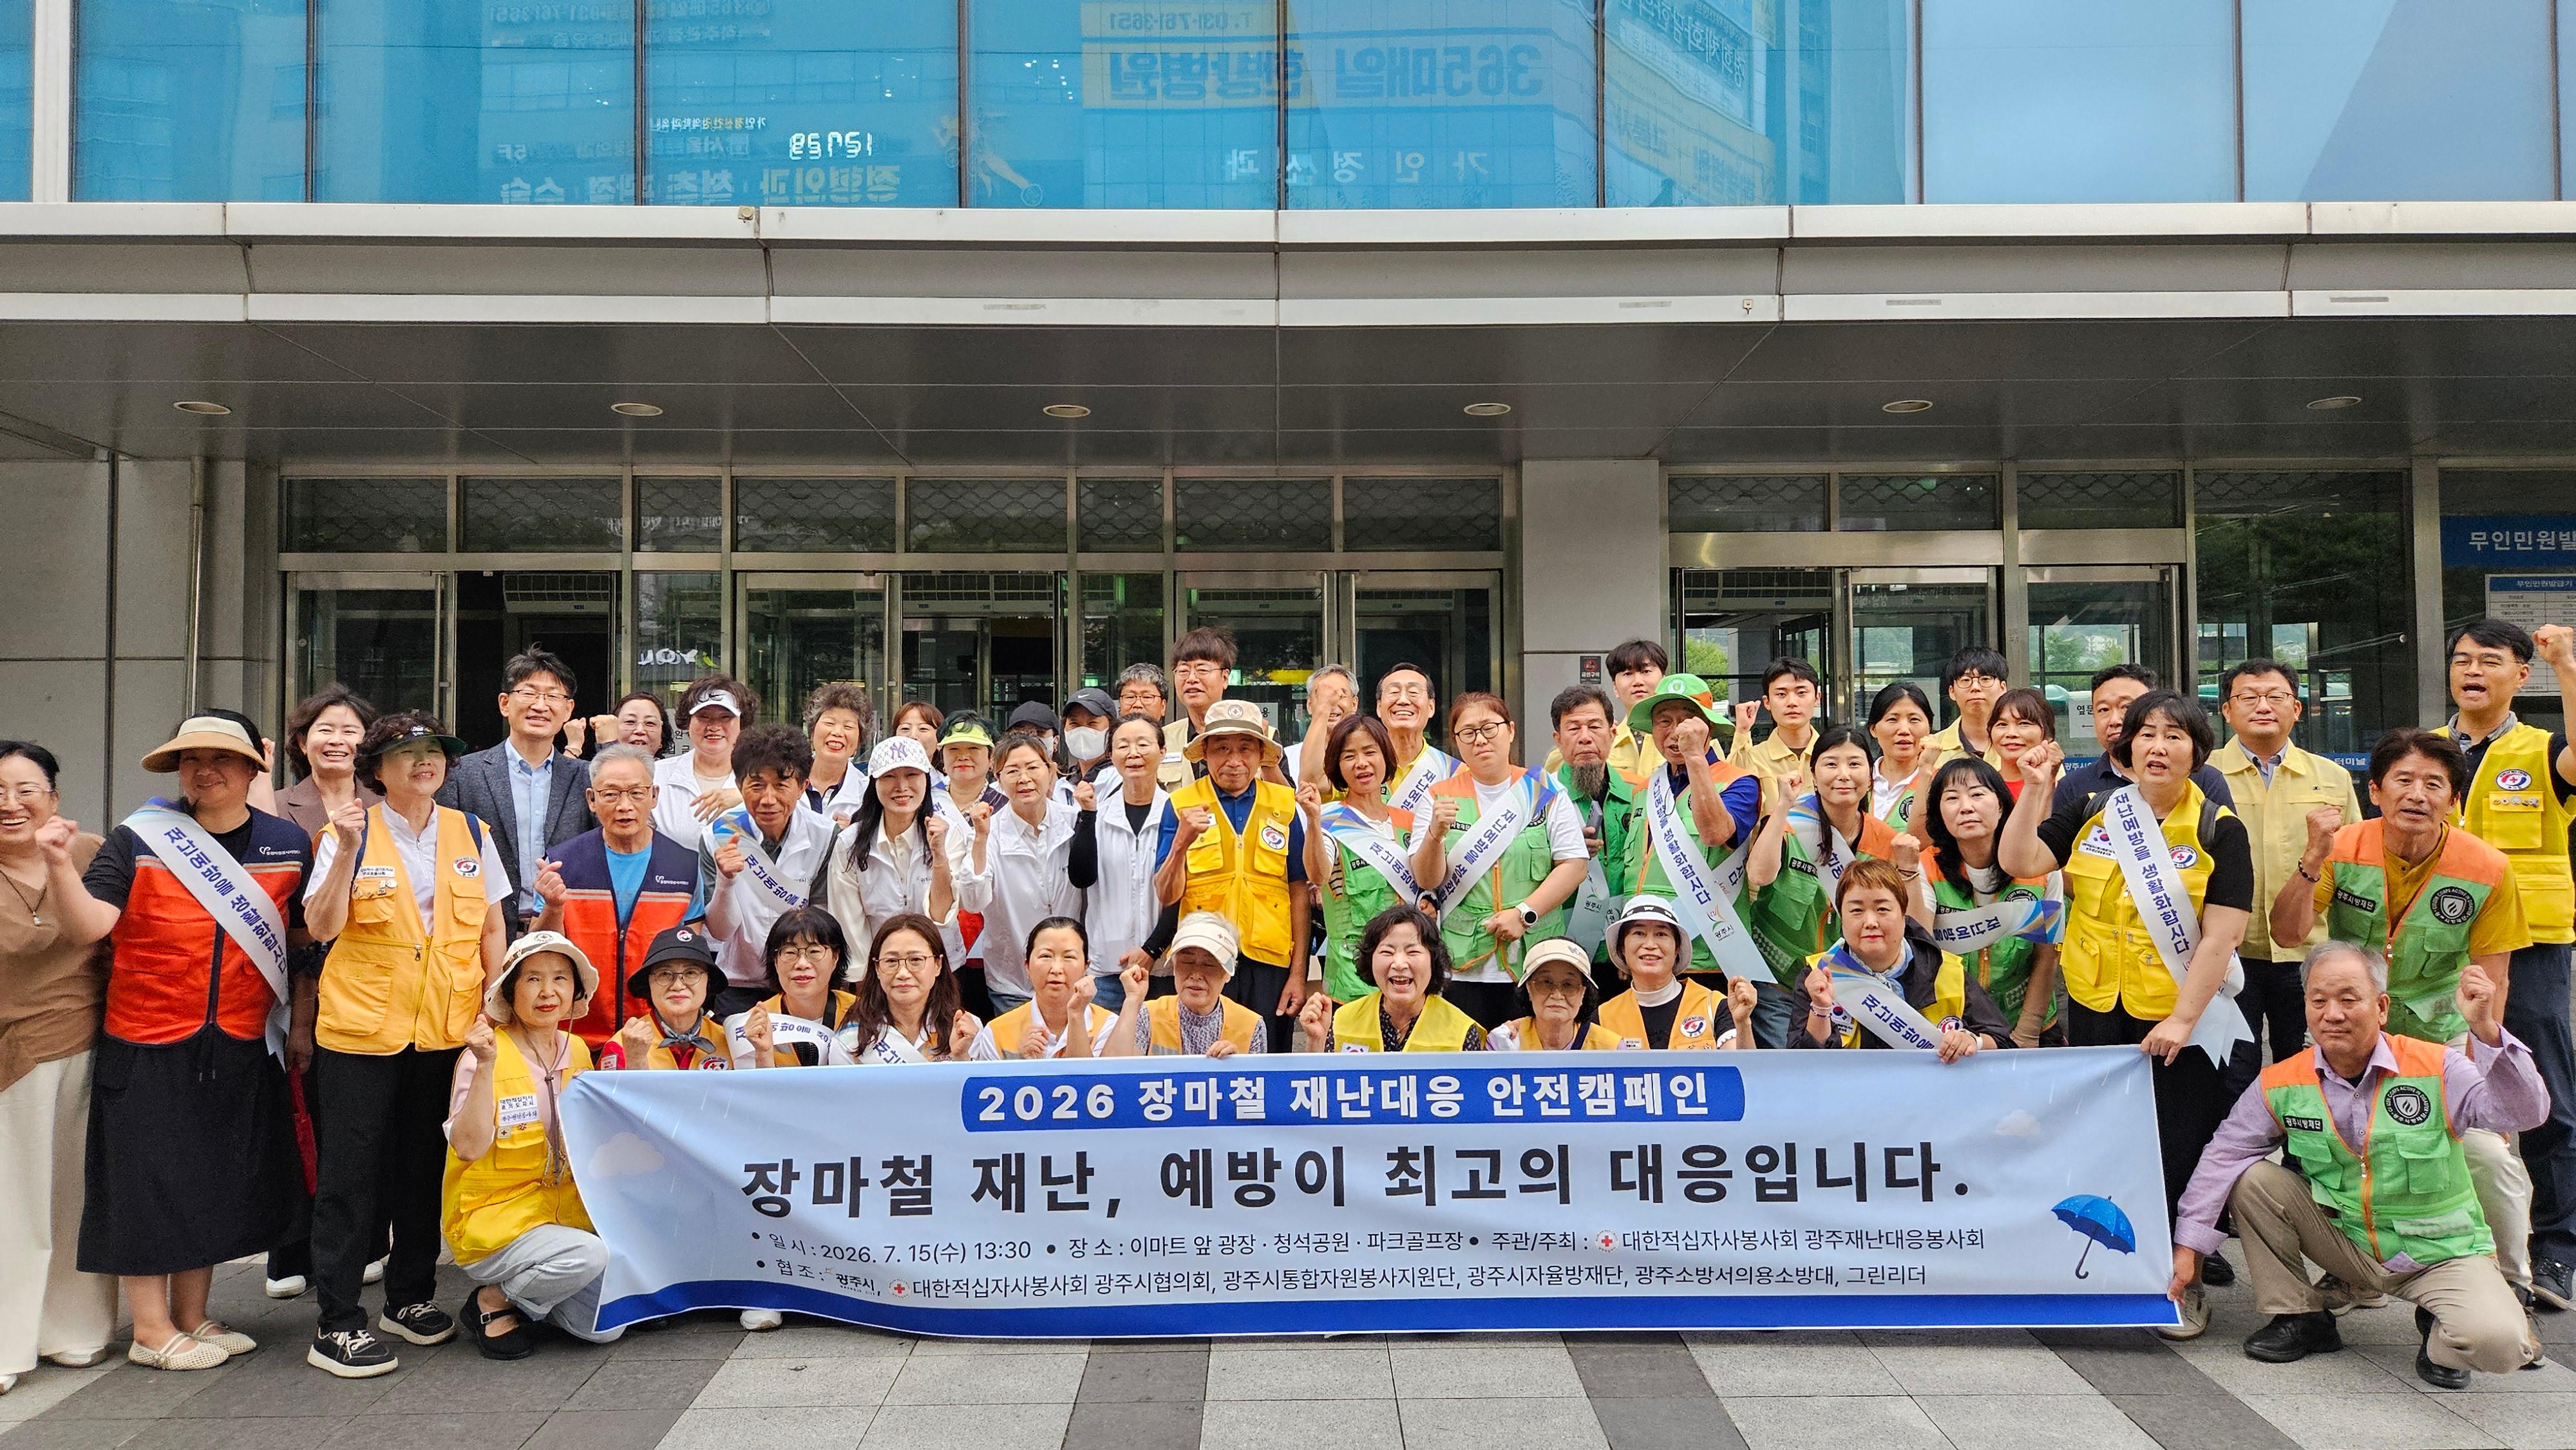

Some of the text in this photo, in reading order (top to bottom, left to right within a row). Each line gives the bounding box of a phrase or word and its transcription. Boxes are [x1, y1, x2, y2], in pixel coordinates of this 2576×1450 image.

[164, 826, 236, 897] 재난예방을
[1464, 809, 1517, 865] 재난예방을
[744, 853, 799, 905] 재난예방을
[2114, 793, 2152, 861] 재난예방을
[2141, 863, 2190, 954] 생활화합시다
[2336, 890, 2374, 910] 광주시방재단
[1715, 925, 1734, 939] 광주시
[978, 1071, 1710, 1123] 2026 장마철 재난대응 안전캠페인
[2285, 1117, 2321, 1129] 광주시방재단
[741, 1142, 1967, 1218] 장마철 재난, 예방이 최고의 대응입니다.
[821, 1245, 876, 1263] 2026.
[884, 1246, 900, 1263] 7.
[909, 1243, 965, 1264] 15(수)
[974, 1241, 1030, 1259] 13:30
[1131, 1236, 1187, 1257] 이마트
[1194, 1236, 1211, 1255] 앞
[1218, 1234, 1256, 1255] 광장
[1274, 1232, 1349, 1254] 청석공원
[1368, 1232, 1463, 1251] 파크골프장
[1492, 1232, 1575, 1251] 주관/주최
[1623, 1230, 1797, 1251] 대한적십자사봉사회
[1805, 1229, 1984, 1250] 광주재난대응봉사회
[913, 1274, 1086, 1298] 대한적십자사봉사회
[1095, 1272, 1215, 1294] 광주시협의회,
[1224, 1266, 1460, 1290] 광주시통합자원봉사지원단,
[1468, 1265, 1627, 1287] 광주시자율방재단,
[1636, 1266, 1839, 1287] 광주소방서의용소방대,
[1847, 1266, 1924, 1285] 그린리더
